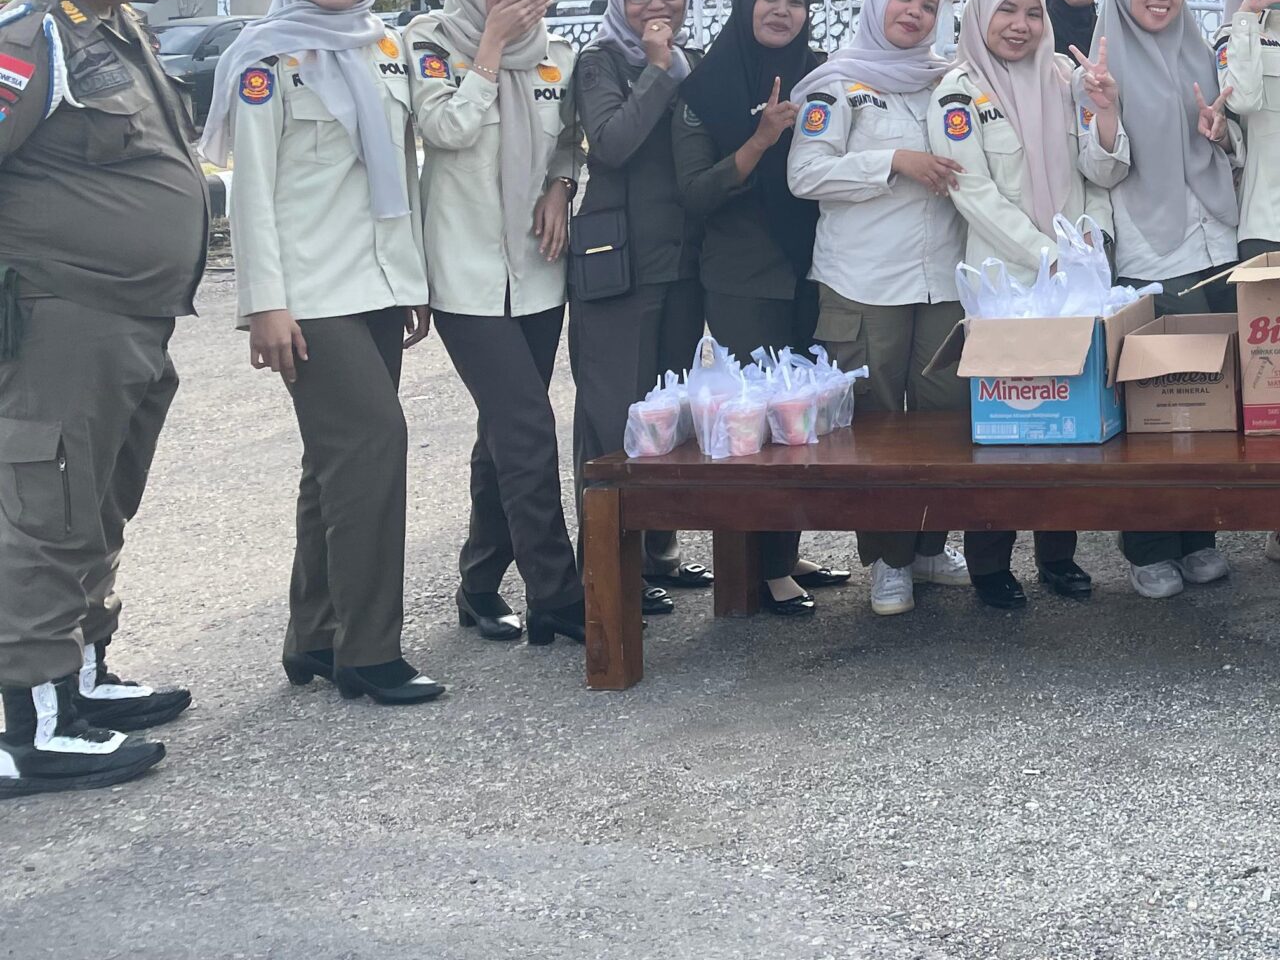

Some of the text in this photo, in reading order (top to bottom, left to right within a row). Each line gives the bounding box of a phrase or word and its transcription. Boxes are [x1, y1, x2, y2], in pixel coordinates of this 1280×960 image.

[379, 62, 404, 75] POL
[534, 87, 561, 101] POL
[979, 378, 1070, 401] Minerale
[1176, 387, 1211, 395] MINERAL
